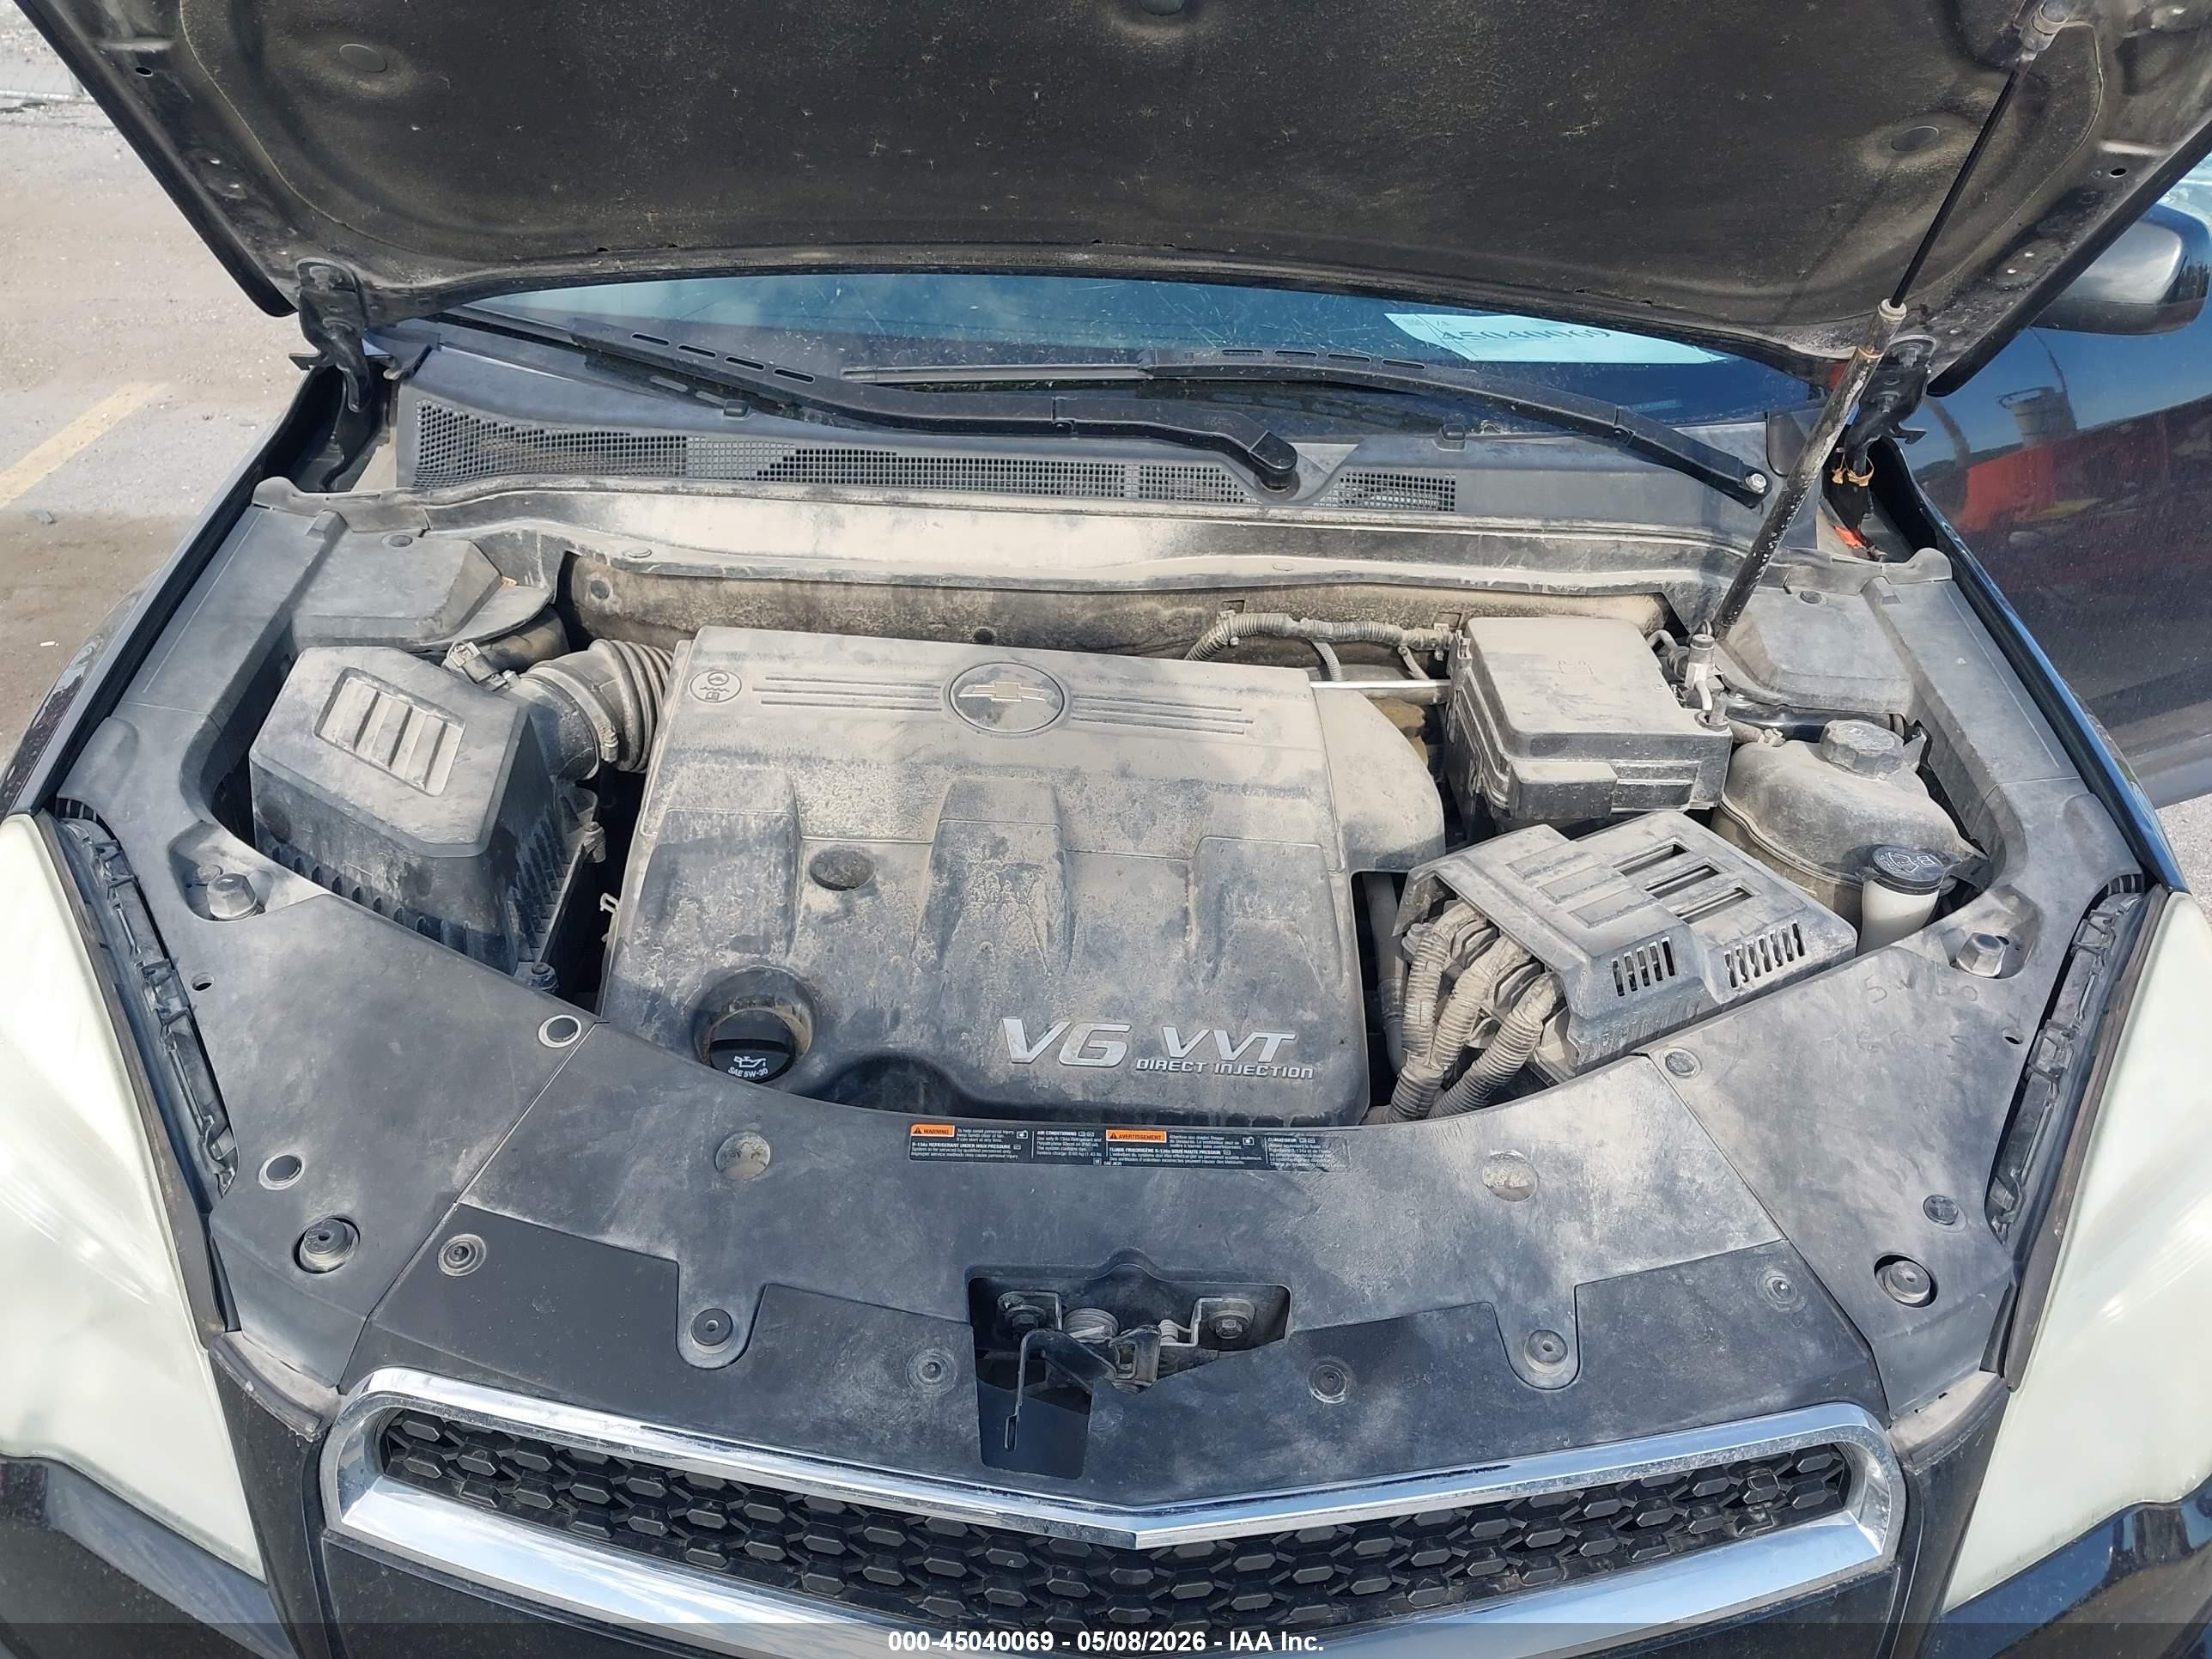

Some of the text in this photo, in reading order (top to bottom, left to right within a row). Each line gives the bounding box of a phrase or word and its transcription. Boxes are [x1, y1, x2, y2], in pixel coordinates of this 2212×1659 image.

[1442, 330, 1611, 341] 45040069
[1001, 1017, 1297, 1067] V6 VVT
[728, 1066, 769, 1078] SAE 5W-30
[1135, 1059, 1315, 1079] DIRECT INJECTION
